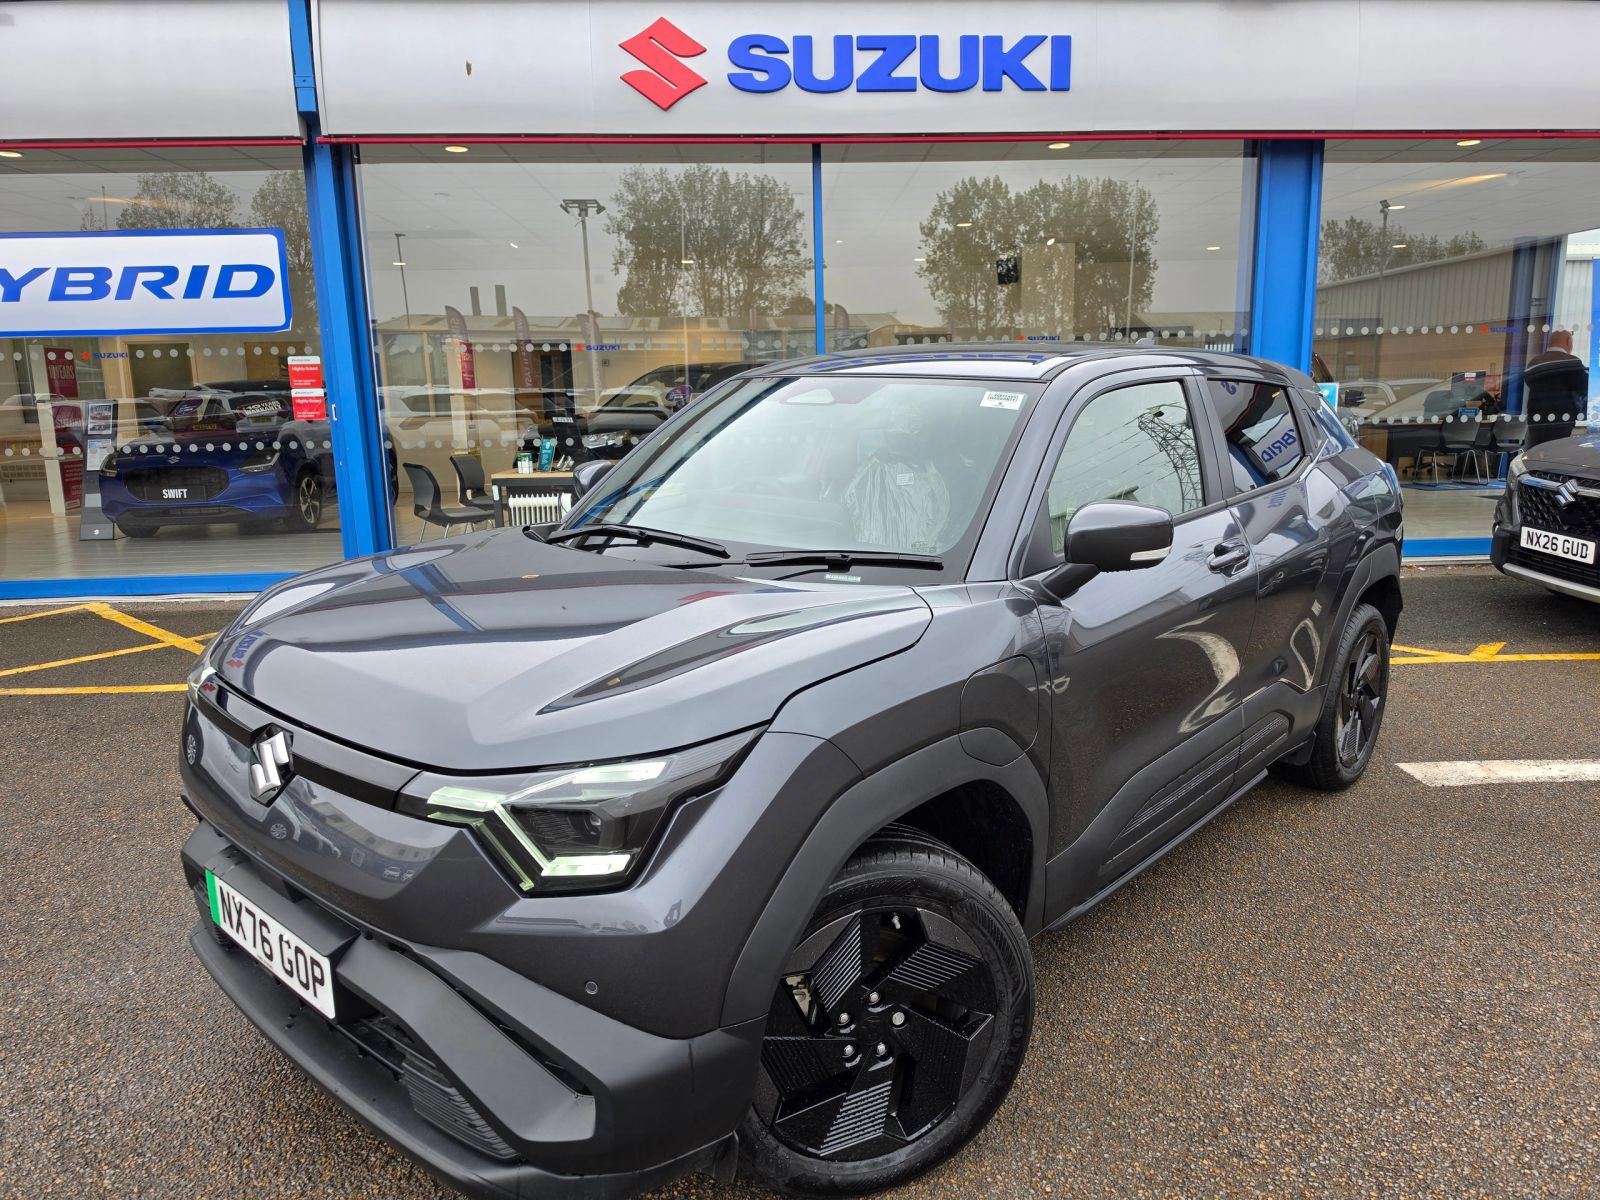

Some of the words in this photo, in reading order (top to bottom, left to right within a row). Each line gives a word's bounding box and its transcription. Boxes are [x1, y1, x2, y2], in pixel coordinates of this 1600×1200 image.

[727, 34, 1072, 93] SUZUKI
[245, 405, 281, 415] WARRANTY
[162, 488, 188, 499] SWIFT
[1526, 530, 1559, 552] NX26
[1562, 539, 1589, 559] GUD
[219, 885, 274, 963] NX76
[278, 933, 326, 999] GOP
